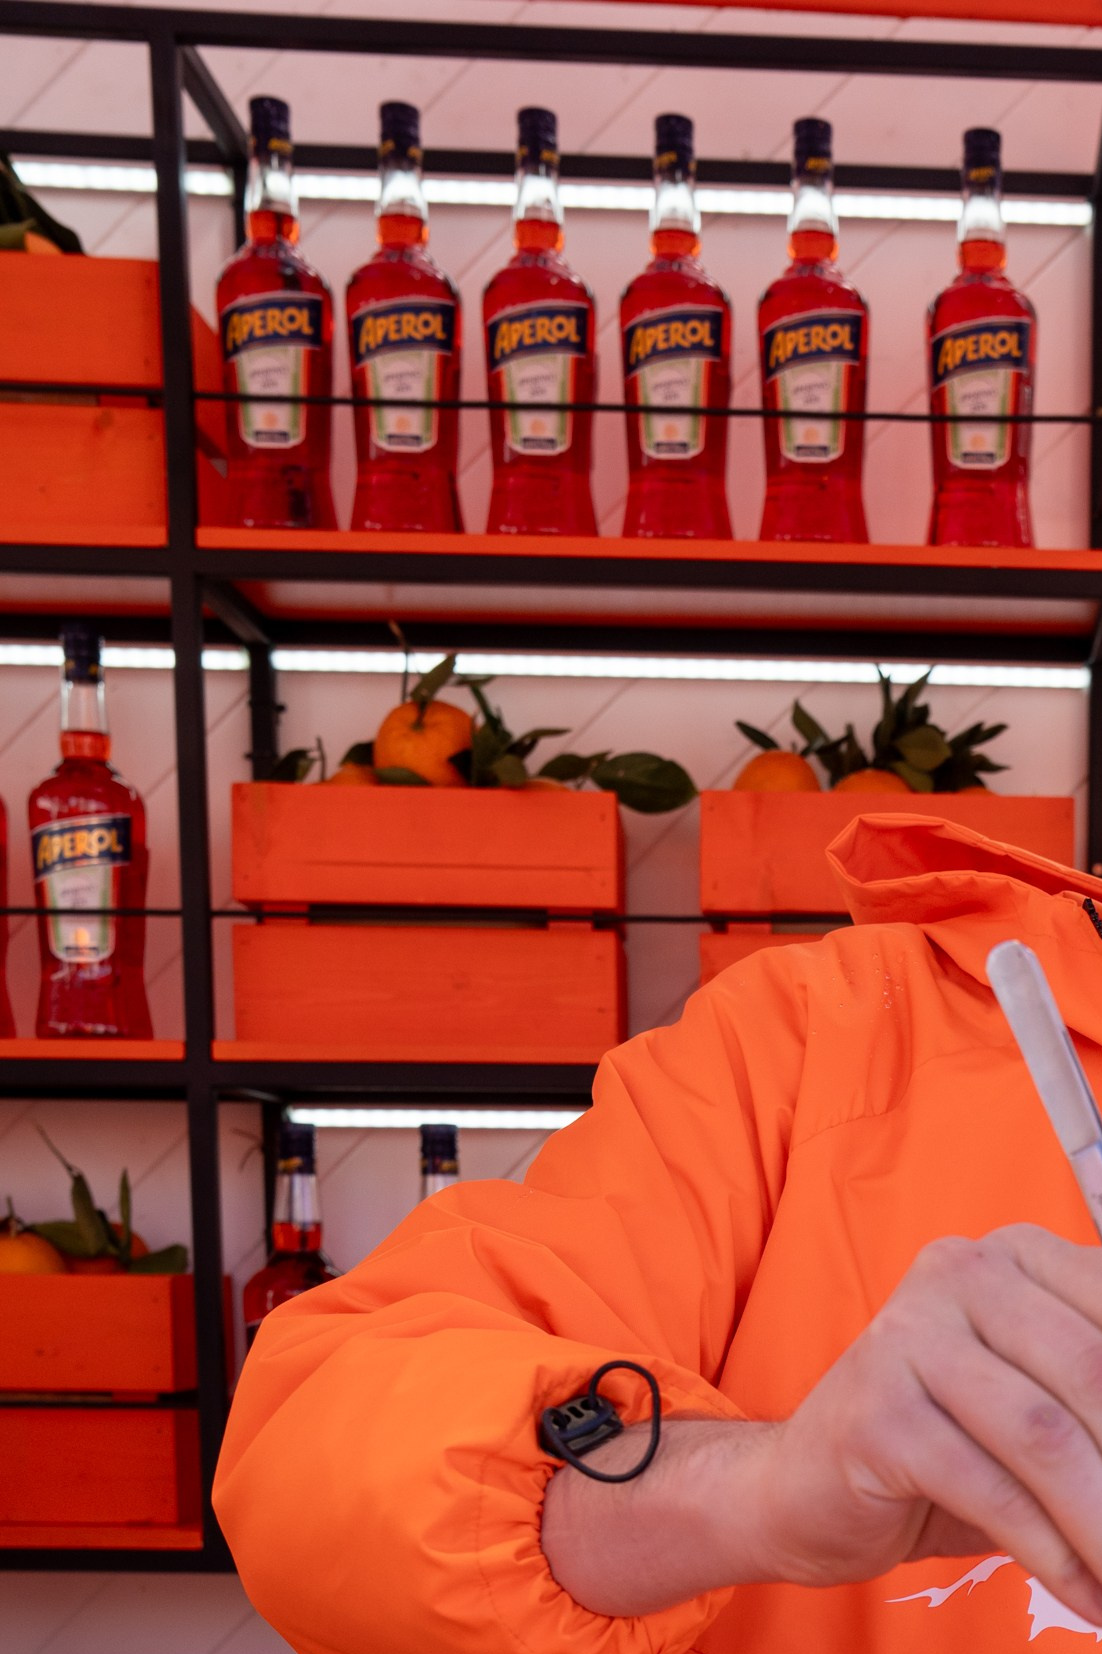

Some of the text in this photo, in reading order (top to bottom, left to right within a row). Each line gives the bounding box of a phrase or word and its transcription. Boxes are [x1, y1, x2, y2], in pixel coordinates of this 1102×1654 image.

[227, 307, 314, 352] APEROL
[359, 312, 446, 354] APEROL
[494, 316, 581, 358] APEROL
[630, 320, 714, 364] APEROL
[769, 324, 854, 368] APEROL
[937, 331, 1022, 375] APEROL
[37, 828, 123, 869] APEROL
